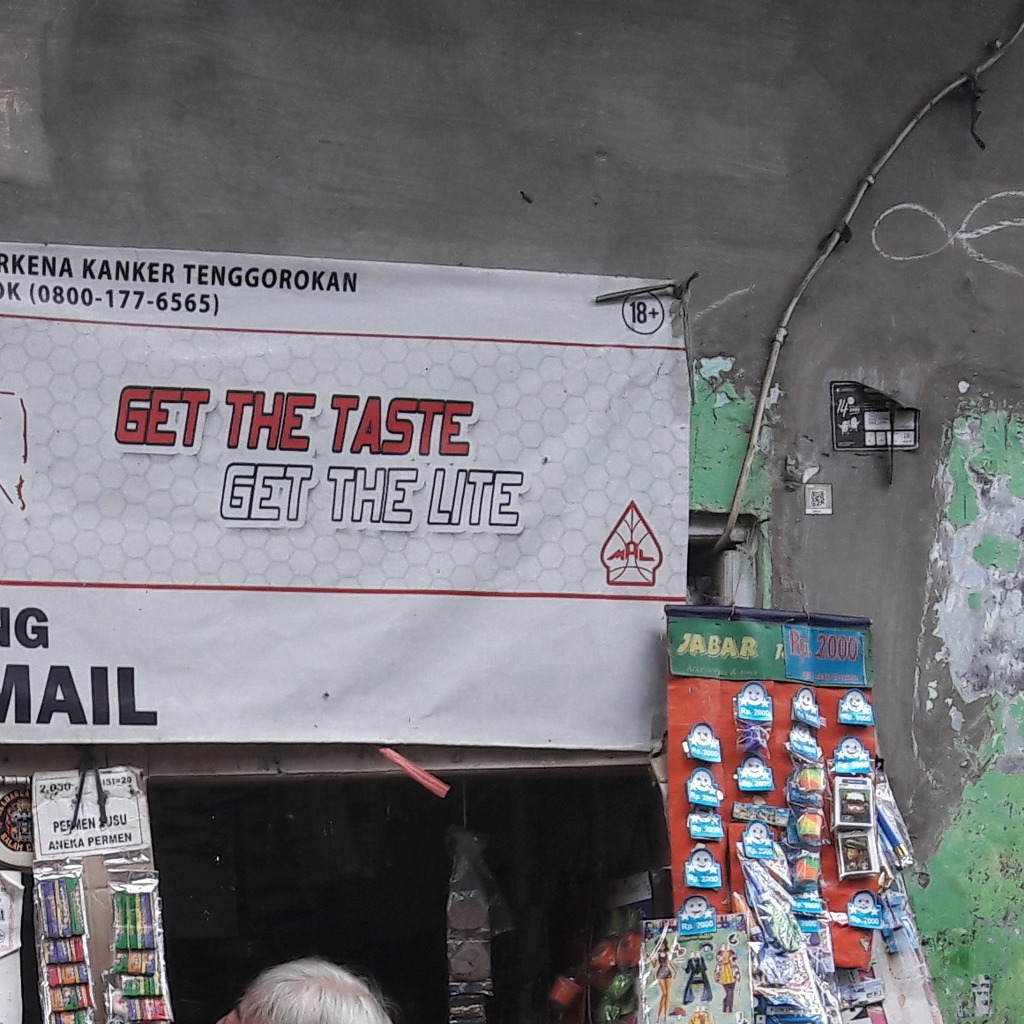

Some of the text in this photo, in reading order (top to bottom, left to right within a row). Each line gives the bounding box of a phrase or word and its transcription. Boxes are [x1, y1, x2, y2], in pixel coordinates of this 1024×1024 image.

[82, 258, 175, 284] KANKER
[183, 263, 358, 293] TENGGOROKAN
[29, 283, 220, 317] (0800-177-6565)
[629, 301, 660, 324] 18+
[115, 385, 474, 456] GET THE TASTE
[220, 462, 524, 526] GET THE LITE
[676, 632, 760, 661] JABAR
[816, 633, 859, 661] 2000
[48, 838, 85, 851] ANEKA
[88, 832, 132, 847] PERMEN
